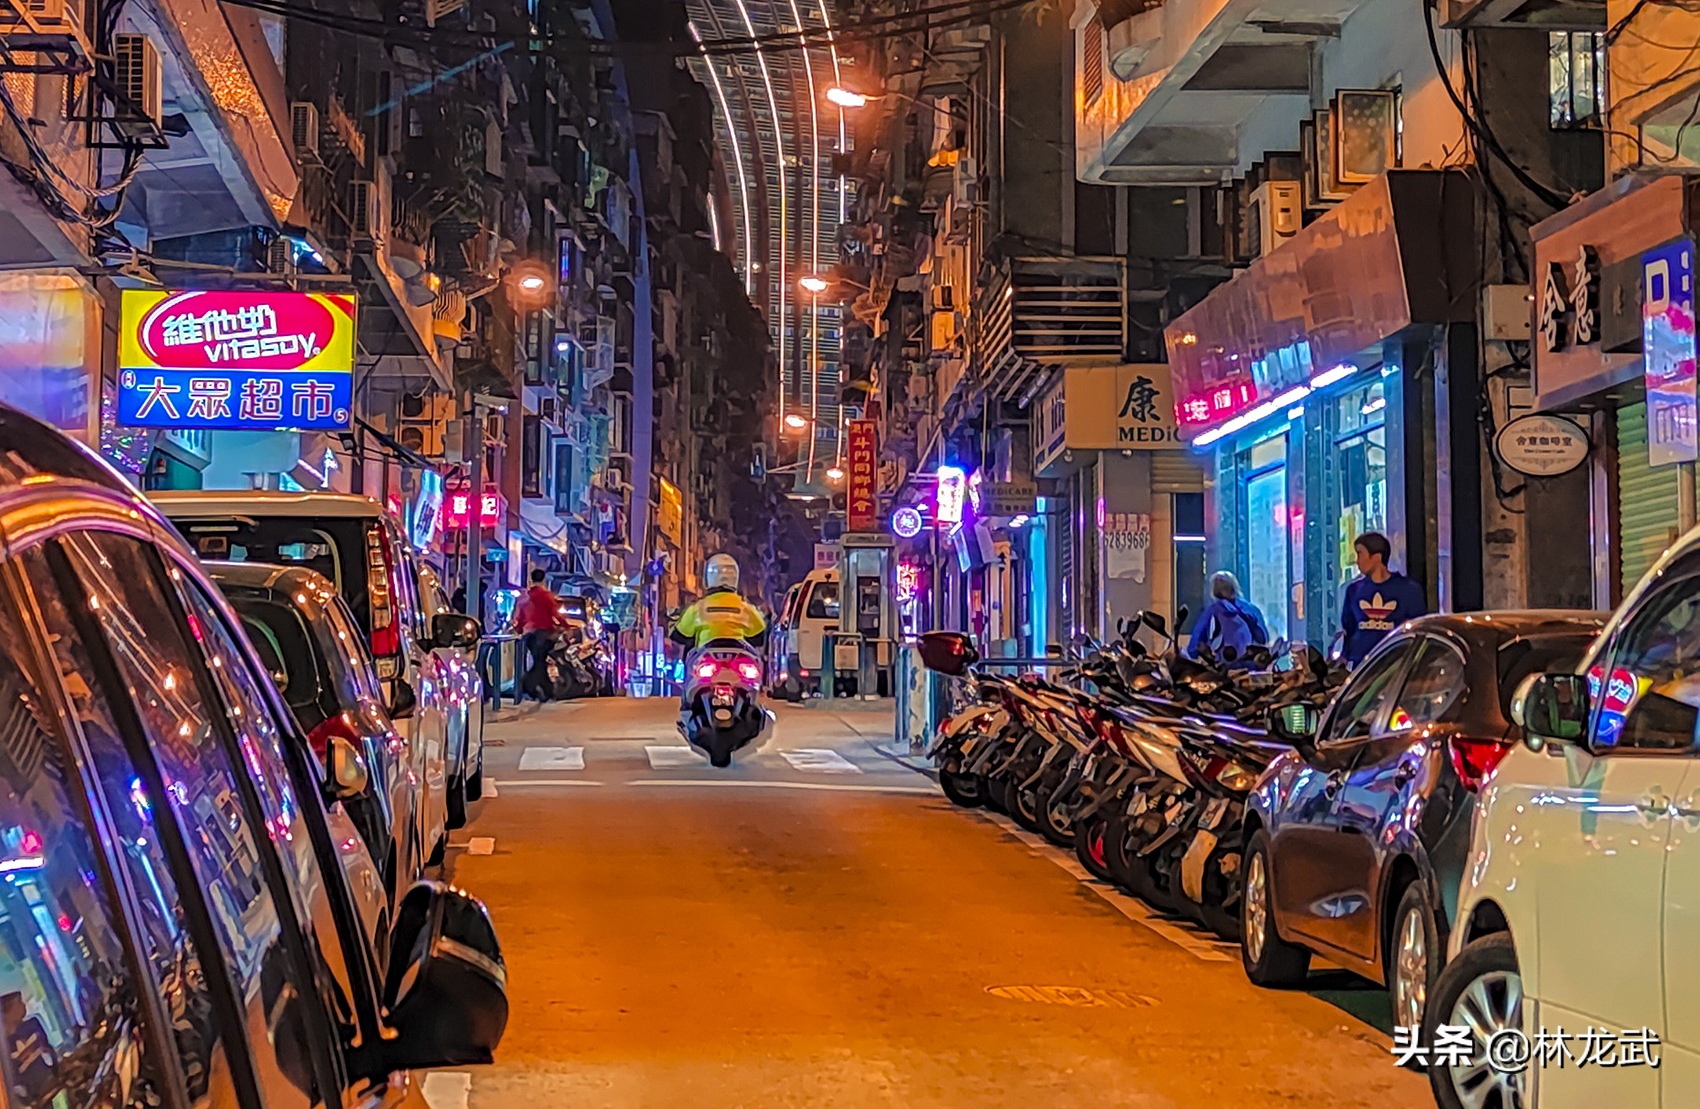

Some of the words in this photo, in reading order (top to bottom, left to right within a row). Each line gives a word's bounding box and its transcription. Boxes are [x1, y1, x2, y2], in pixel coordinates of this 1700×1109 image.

[162, 304, 277, 346] 維他奶
[204, 332, 317, 362] vitasoy
[136, 376, 335, 421] 大眾超市
[1119, 376, 1160, 422] 康
[1359, 619, 1394, 630] adidas
